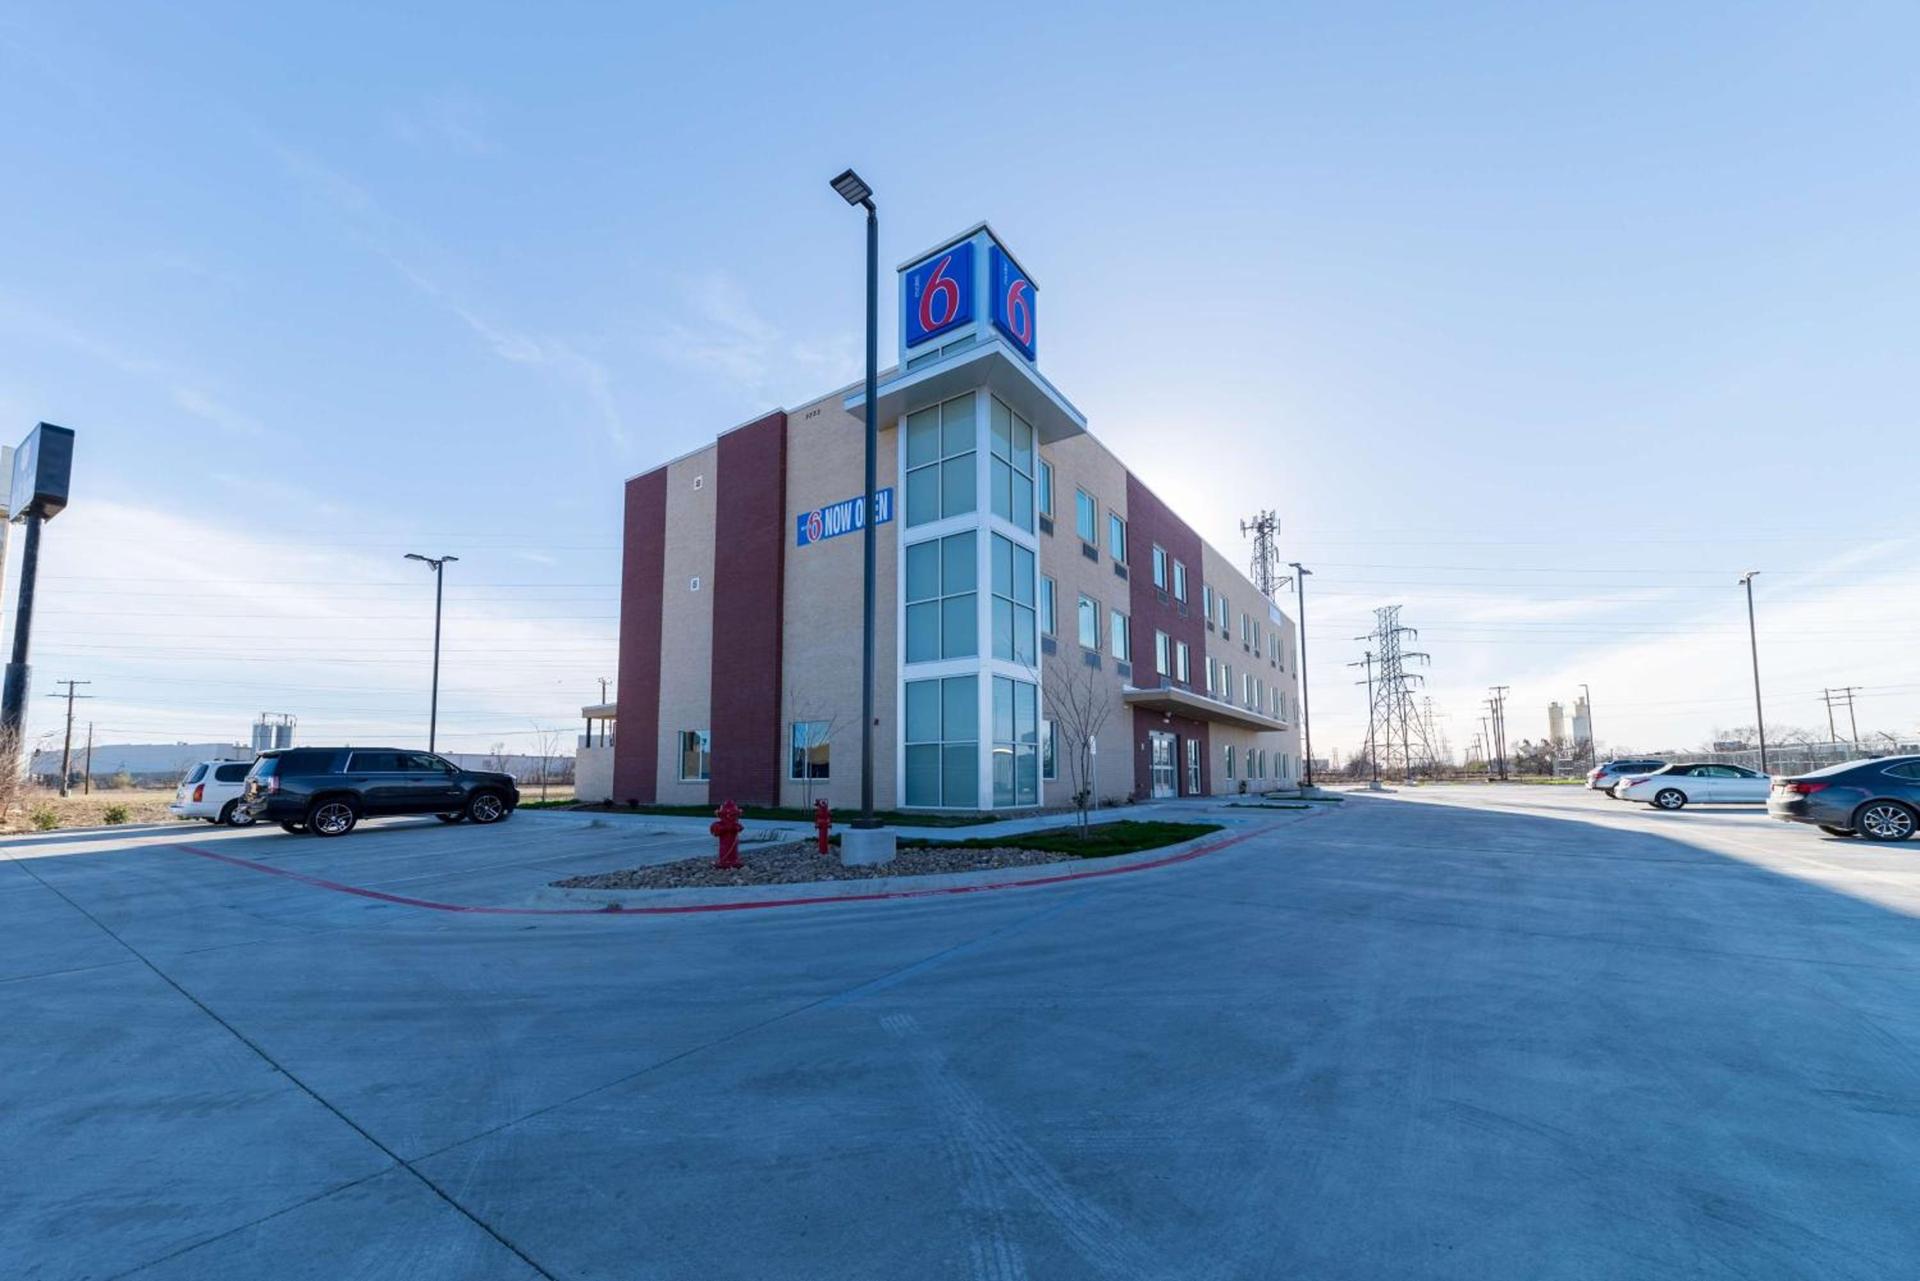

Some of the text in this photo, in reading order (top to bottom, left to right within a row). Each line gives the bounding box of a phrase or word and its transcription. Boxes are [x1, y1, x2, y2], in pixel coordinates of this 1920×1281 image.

[919, 255, 959, 332] 6
[1007, 279, 1032, 347] 6
[807, 491, 888, 542] 6 NOW OEN
